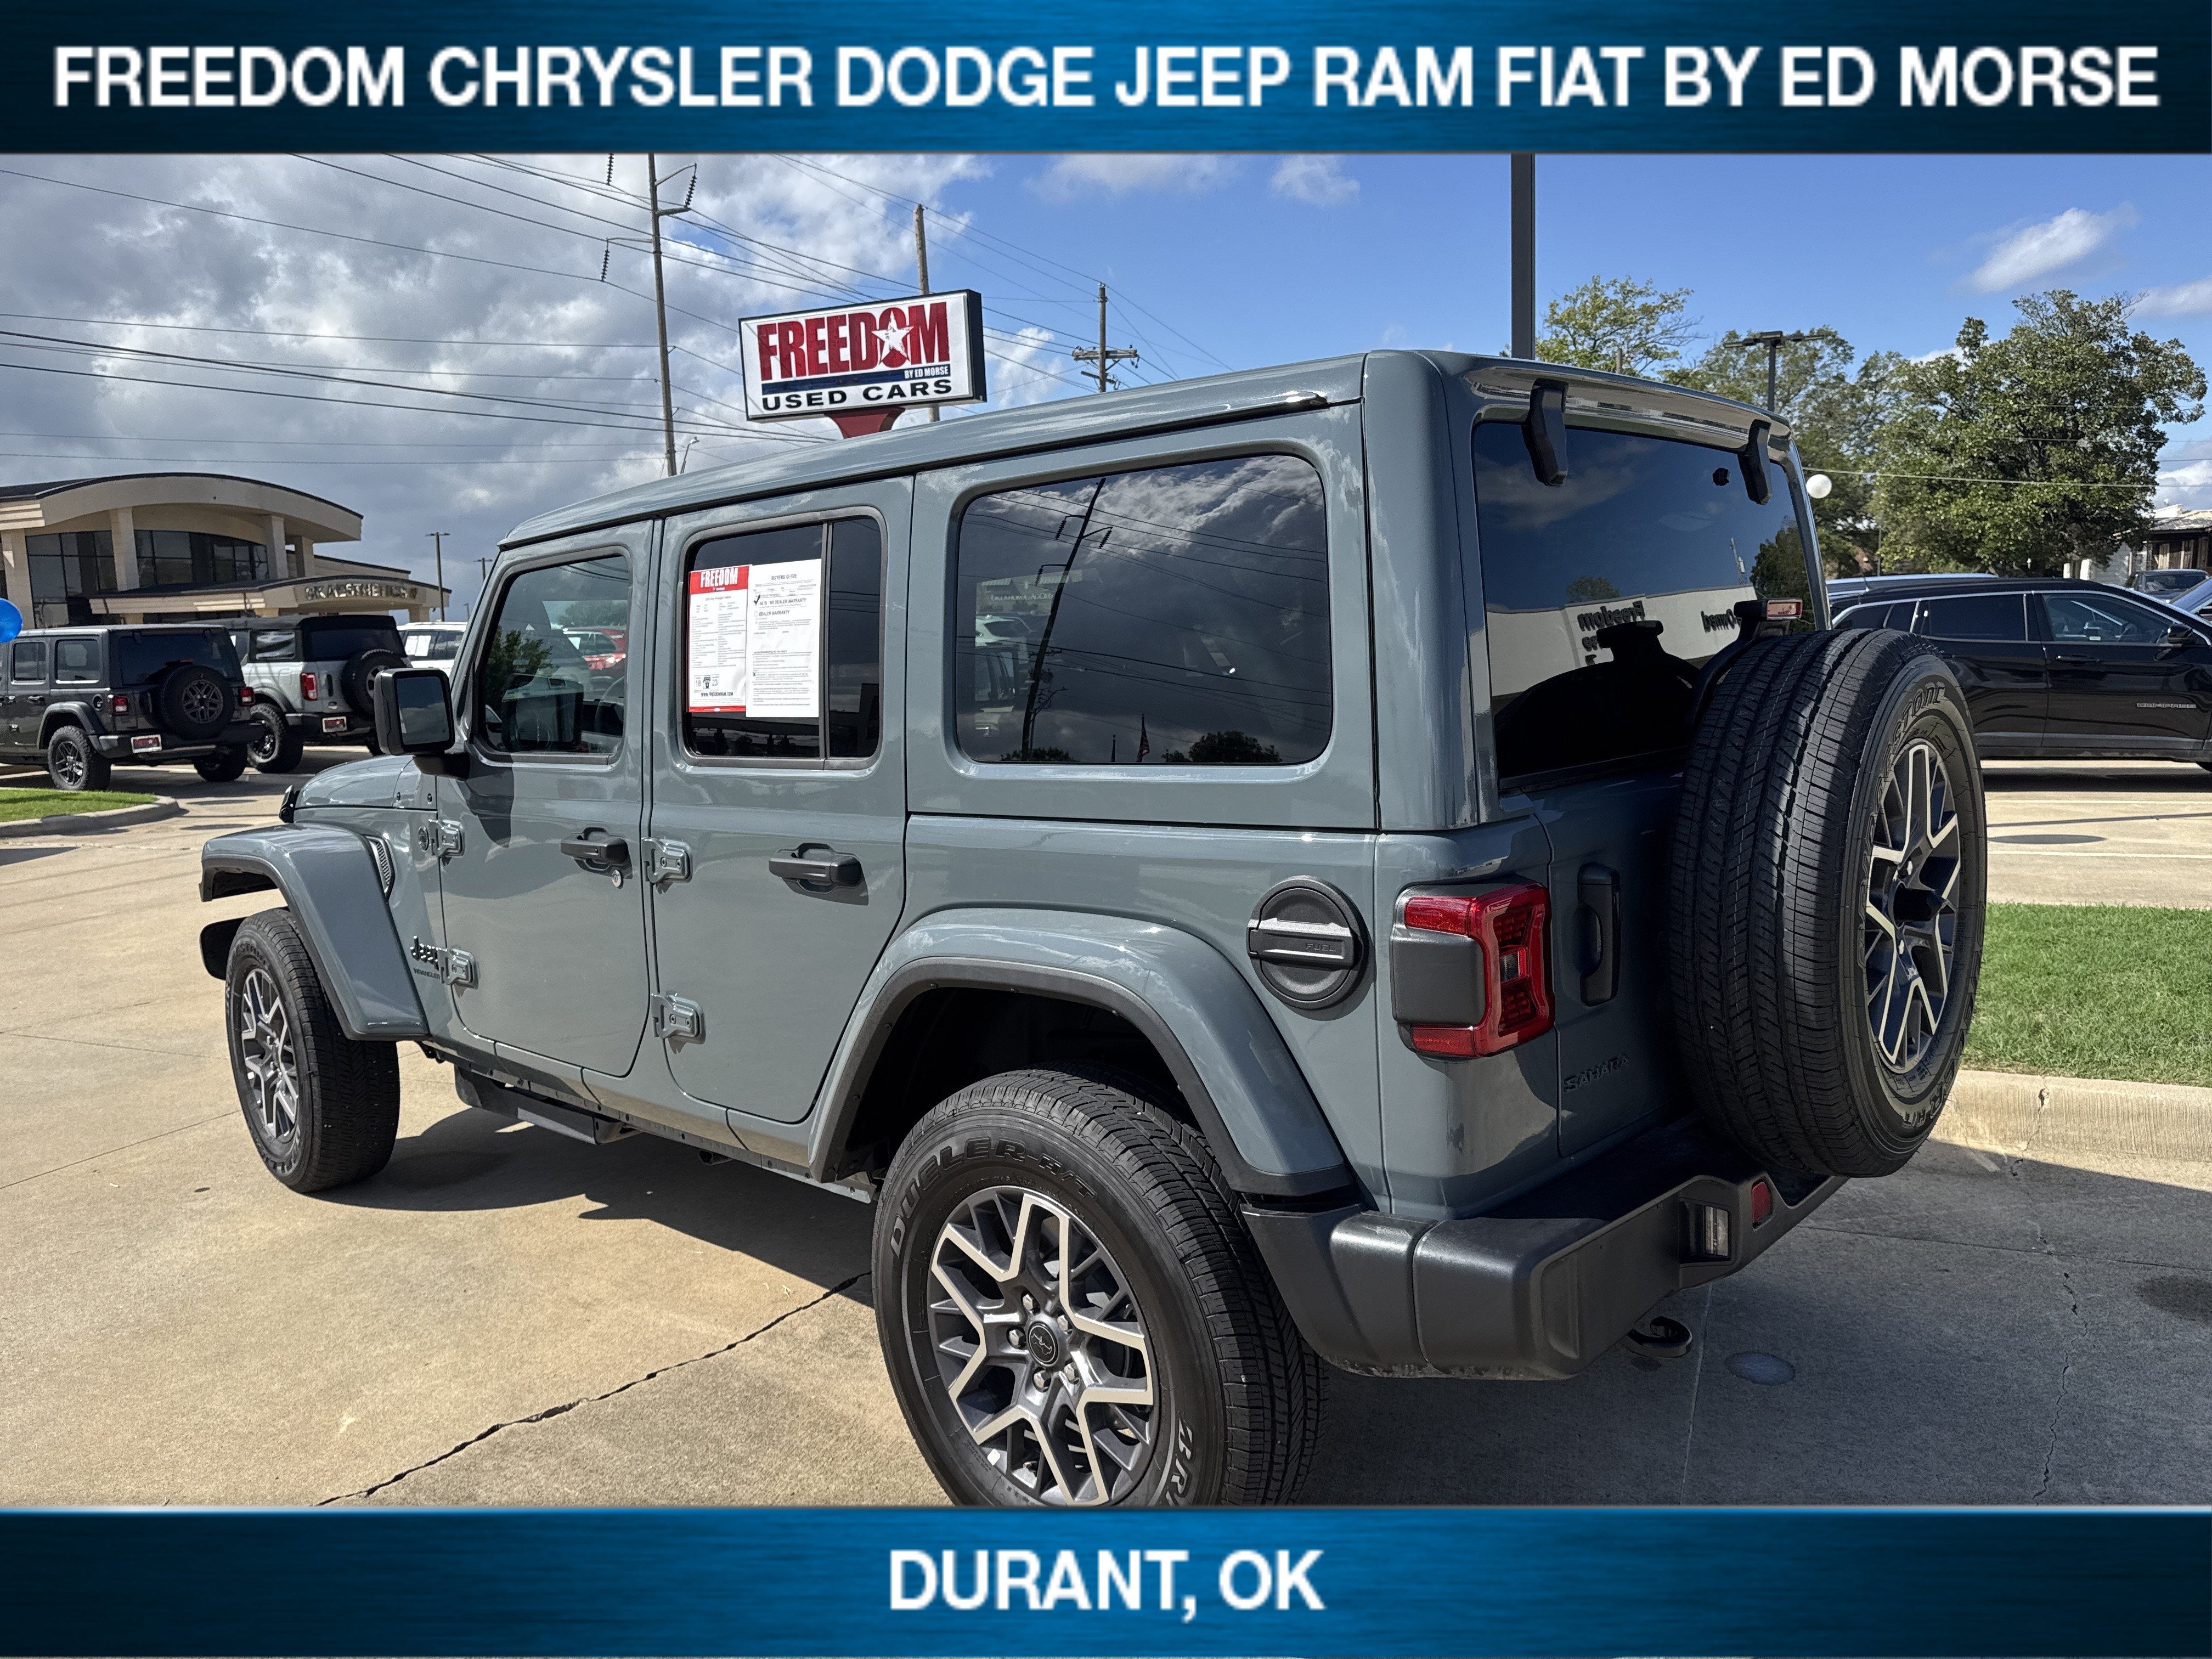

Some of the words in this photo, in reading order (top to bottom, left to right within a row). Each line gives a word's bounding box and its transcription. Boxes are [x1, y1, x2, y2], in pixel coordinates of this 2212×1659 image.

[757, 302, 950, 381] FREEDOM
[904, 370, 913, 379] BY
[915, 369, 923, 377] ED
[924, 366, 949, 377] MORSE
[762, 390, 847, 411] USED
[862, 379, 952, 402] CARS
[700, 567, 738, 589] FREEDOM
[1306, 943, 1336, 952] FUEL
[413, 967, 440, 980] WRANGLER
[890, 1136, 1027, 1260] DUELER
